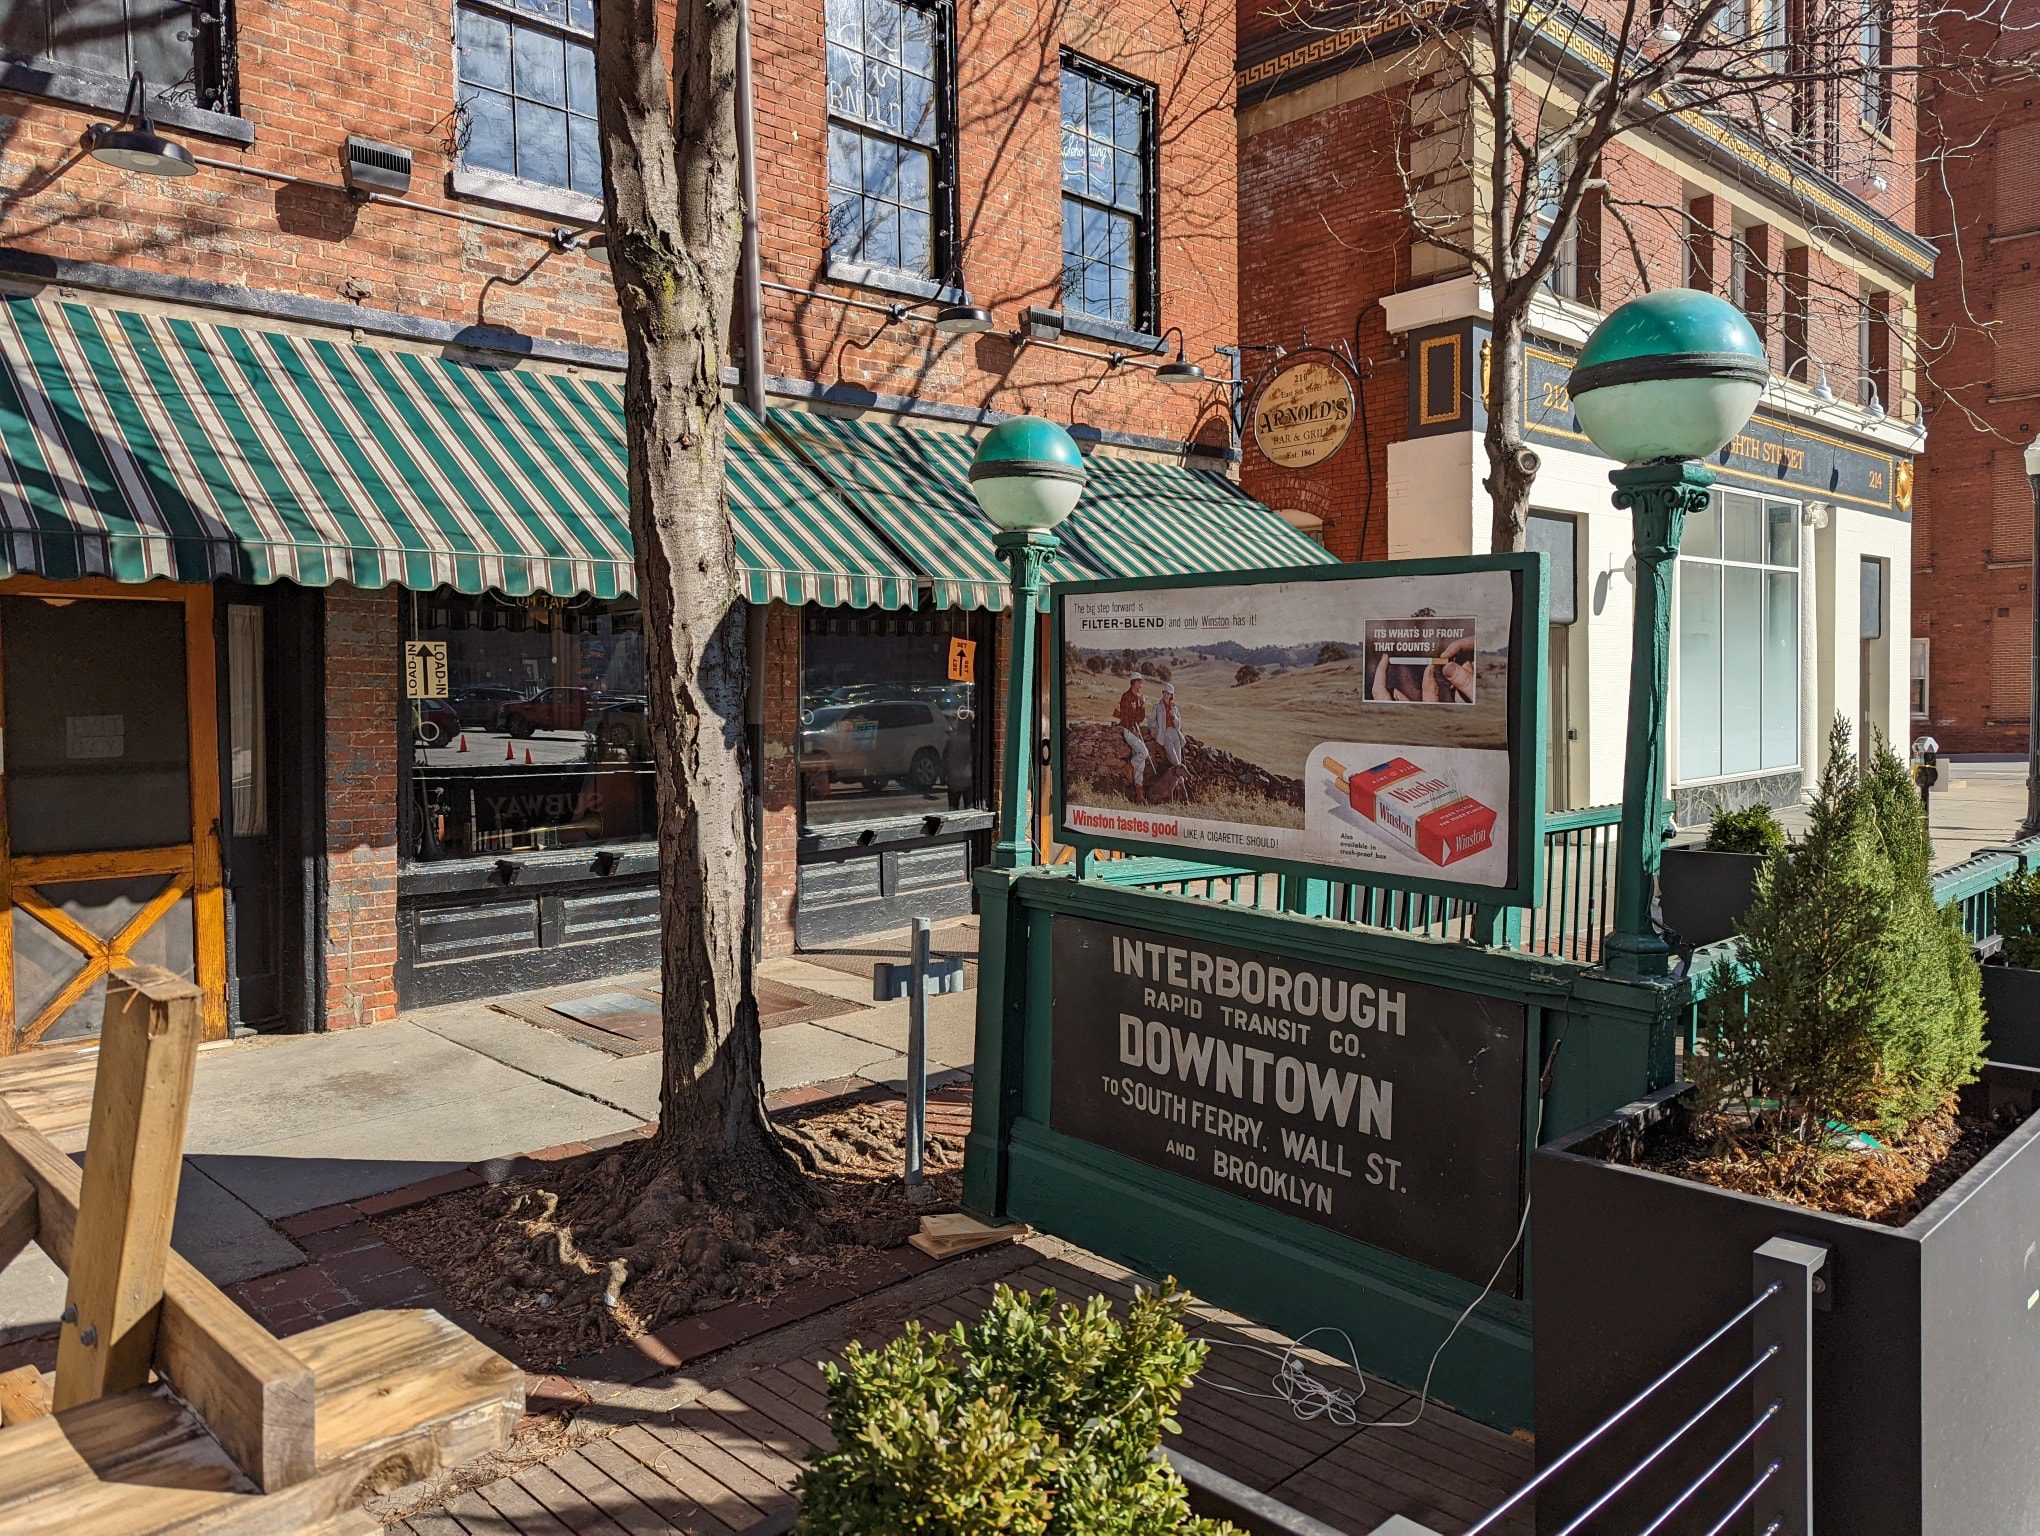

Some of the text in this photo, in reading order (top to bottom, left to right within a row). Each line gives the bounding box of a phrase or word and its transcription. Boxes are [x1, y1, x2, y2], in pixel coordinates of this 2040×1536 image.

[1294, 373, 1308, 382] 210
[1281, 390, 1293, 398] East
[1543, 382, 1569, 412] 212
[1259, 398, 1348, 434] ARNOLD'S
[1273, 434, 1291, 445] BAR
[1294, 433, 1300, 441] &
[1301, 449, 1316, 457] 1861
[1762, 442, 1805, 470] STREET
[1870, 470, 1882, 489] 214
[543, 595, 569, 609] TAP
[1074, 602, 1144, 615] The big step forward is
[1081, 614, 1257, 630] FILTER-BLEND and only Winston has it!
[1422, 628, 1434, 638] UP
[1436, 628, 1464, 638] FRONT
[1374, 642, 1395, 652] THAT
[407, 644, 418, 696] LOAD-IN
[434, 644, 447, 696] LOAD-IN
[1387, 779, 1449, 803] Winston
[1072, 809, 1279, 849] Winston tastes good LIKE A CIGARETTE SHOULD!
[1379, 802, 1412, 838] Winston
[1340, 832, 1354, 840] Also
[1340, 841, 1377, 851] available in
[1455, 828, 1486, 853] Winston
[1340, 848, 1387, 860] crush-proof box
[1112, 935, 1406, 1037] INTERBOROUGH
[1144, 987, 1366, 1059] RAPID TRANSIT CO.
[1119, 1013, 1393, 1141] DOWNTOWN
[1101, 1076, 1118, 1096] TO
[1121, 1077, 1186, 1125] SOUTH
[1281, 1127, 1352, 1178] WALL
[1365, 1152, 1407, 1194] ST.
[1166, 1139, 1332, 1216] AND BROOKLYN
